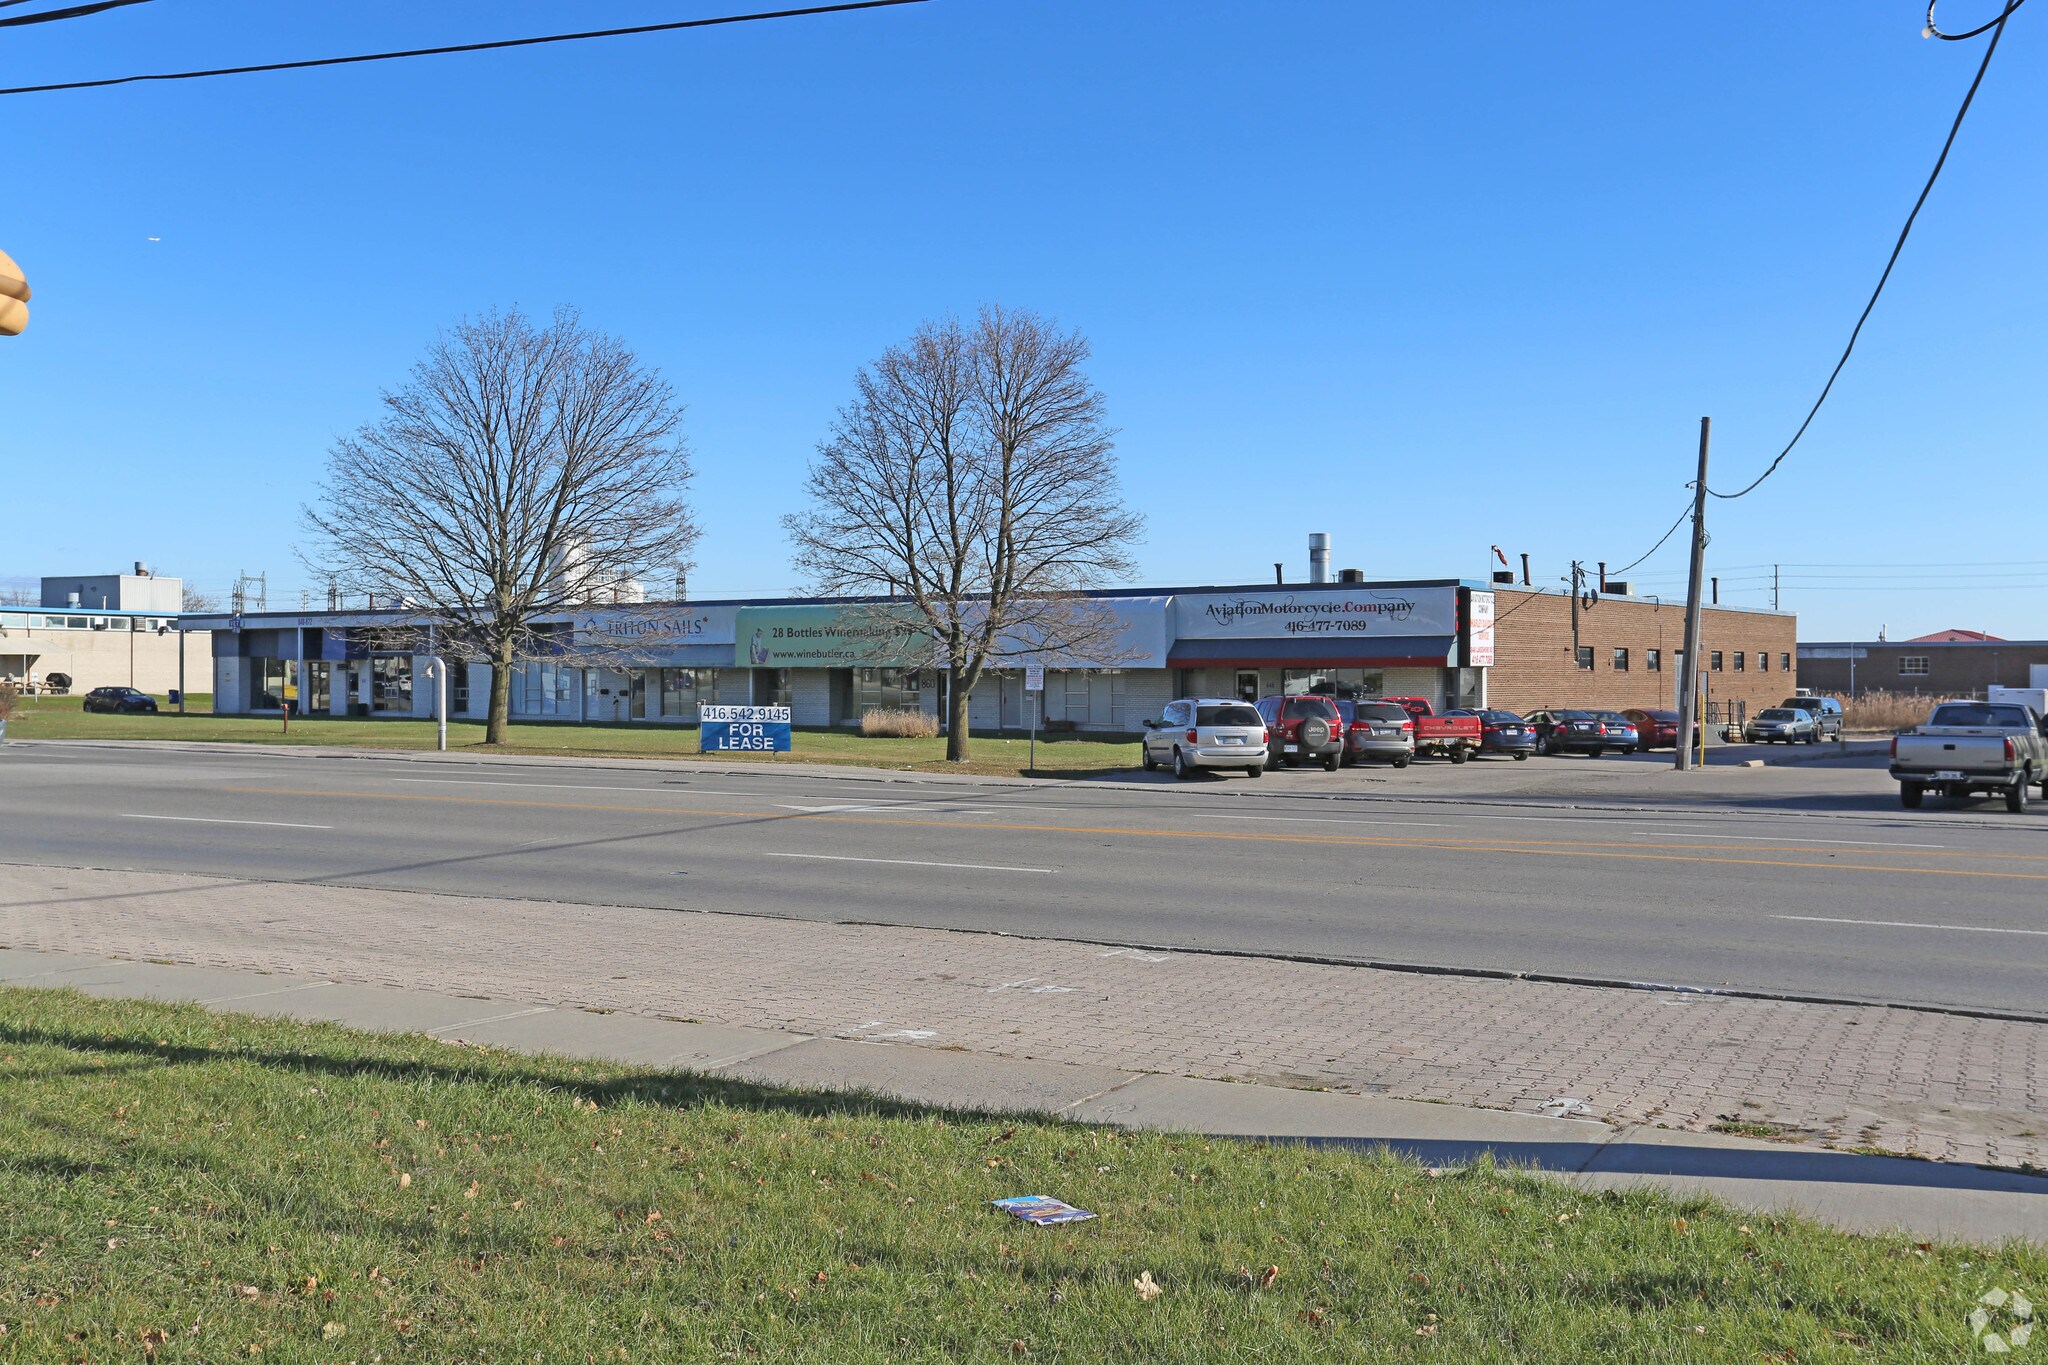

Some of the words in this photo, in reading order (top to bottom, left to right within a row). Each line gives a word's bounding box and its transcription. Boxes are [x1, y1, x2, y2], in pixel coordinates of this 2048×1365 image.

[608, 620, 659, 635] TRITON
[664, 620, 702, 634] SAILS
[772, 628, 783, 638] 28
[787, 627, 822, 638] Bottles
[1285, 620, 1366, 634] 416-477-7089
[773, 649, 855, 658] www.winebutler.ca
[921, 678, 935, 689] 860
[703, 707, 789, 721] 416.542.9145
[729, 723, 763, 736] FOR
[1308, 726, 1324, 734] Jeep
[718, 737, 774, 750] LEASE
